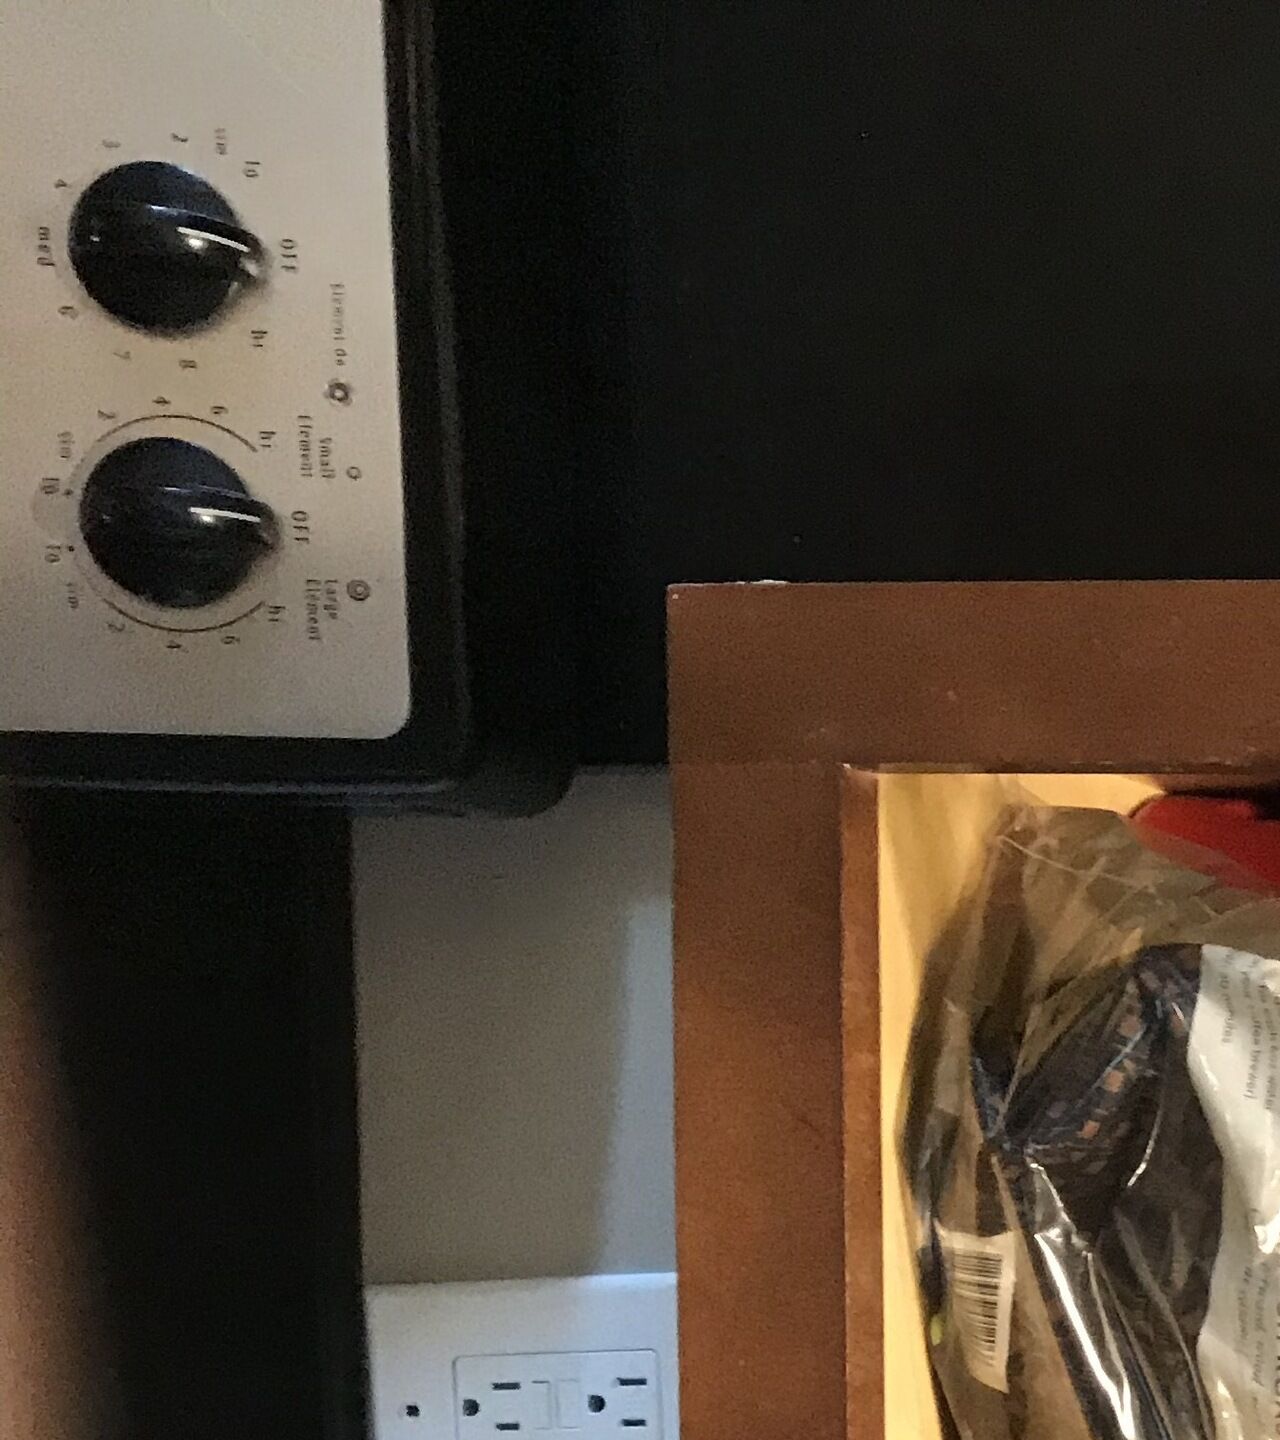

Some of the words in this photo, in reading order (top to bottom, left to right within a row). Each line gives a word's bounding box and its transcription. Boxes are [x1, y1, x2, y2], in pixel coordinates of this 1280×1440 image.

[36, 226, 56, 266] med
[280, 239, 298, 274] OFF
[292, 511, 310, 546] OFF
